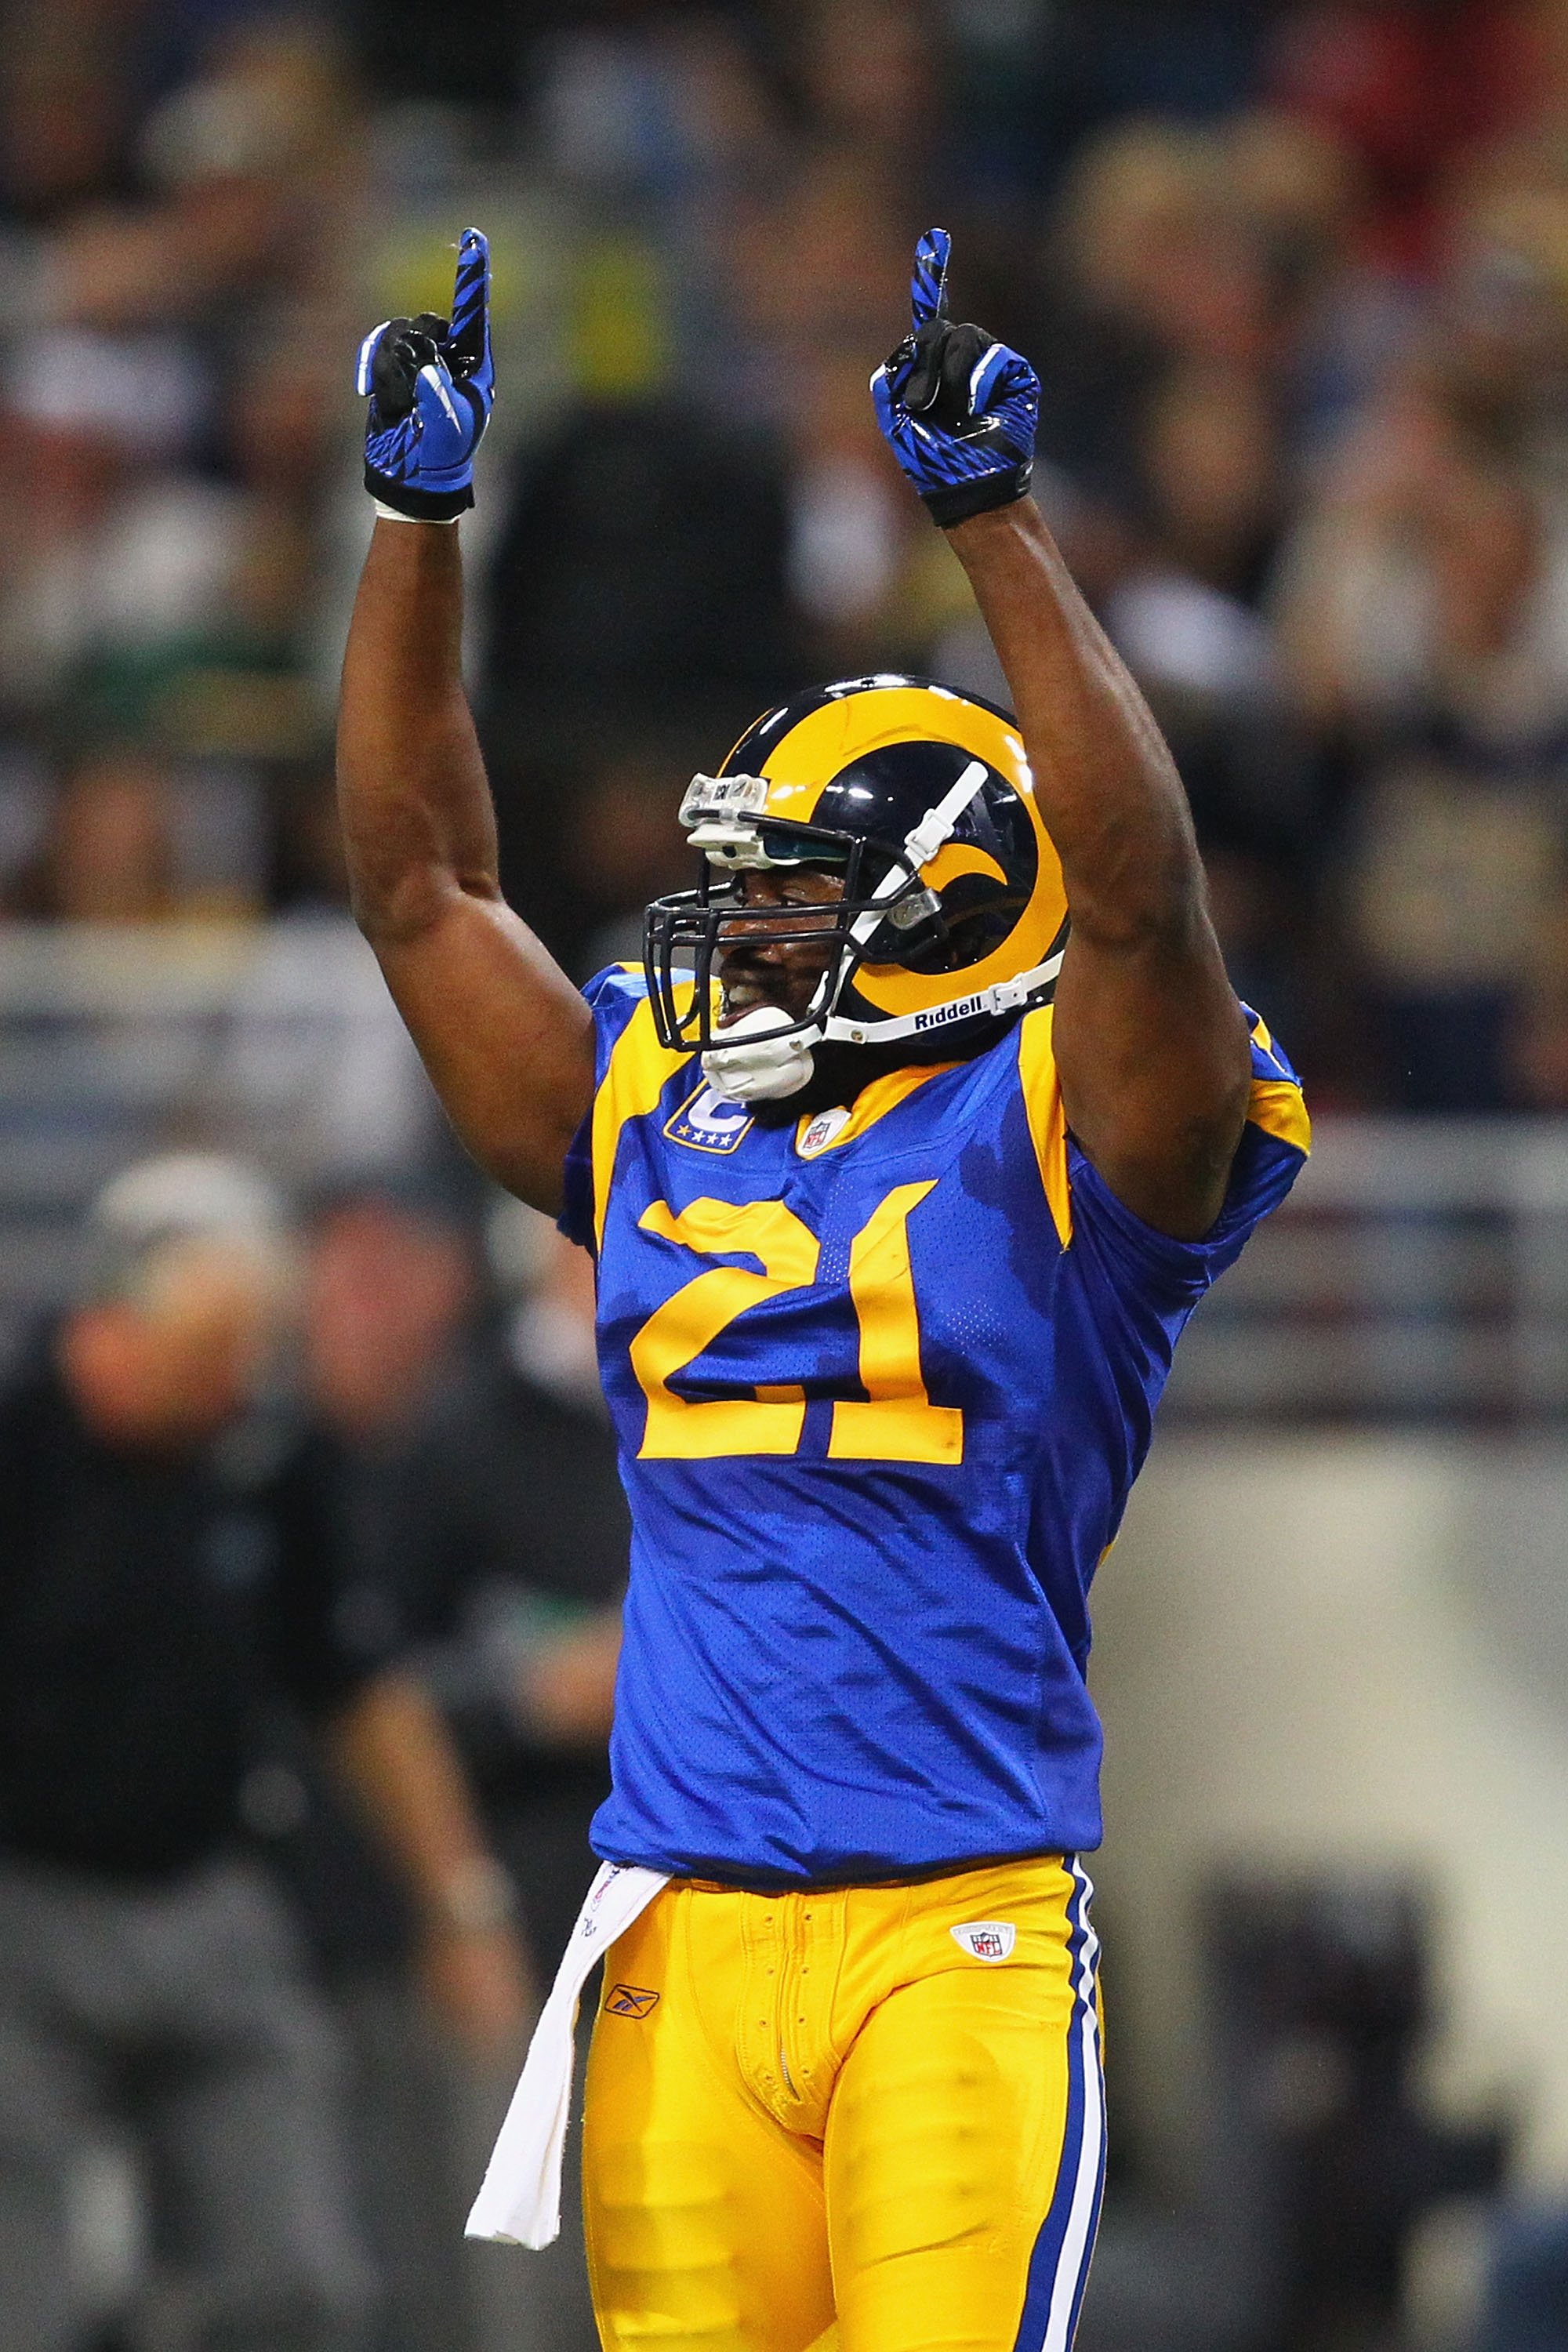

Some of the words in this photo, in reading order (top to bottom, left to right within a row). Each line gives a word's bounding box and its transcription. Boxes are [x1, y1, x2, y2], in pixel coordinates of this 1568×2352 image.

[915, 996, 982, 1030] Riddell
[688, 1088, 748, 1133] C
[629, 1178, 964, 1465] 21
[974, 1942, 1002, 1955] NFL
